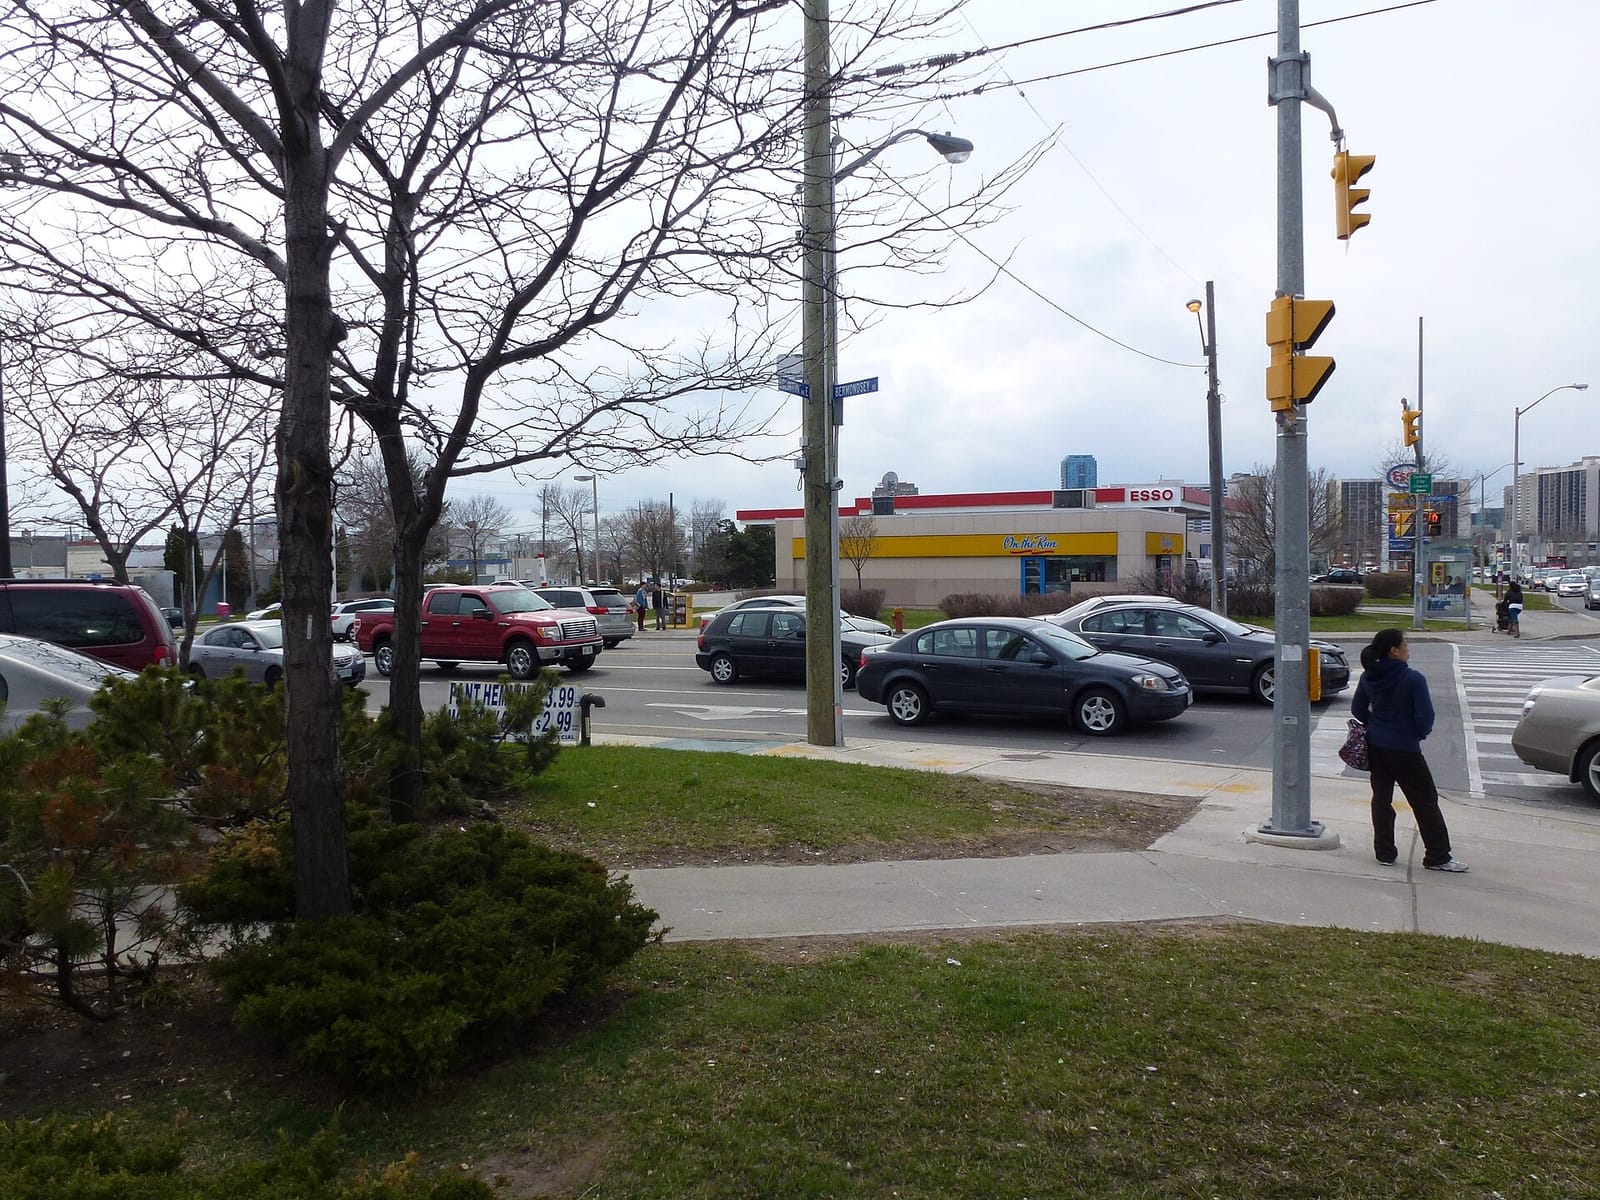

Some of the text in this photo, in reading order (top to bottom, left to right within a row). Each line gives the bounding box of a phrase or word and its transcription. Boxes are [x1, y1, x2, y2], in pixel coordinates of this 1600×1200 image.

[1130, 489, 1174, 502] ESSO
[1002, 535, 1058, 550] On the Run
[535, 710, 572, 732] $299
